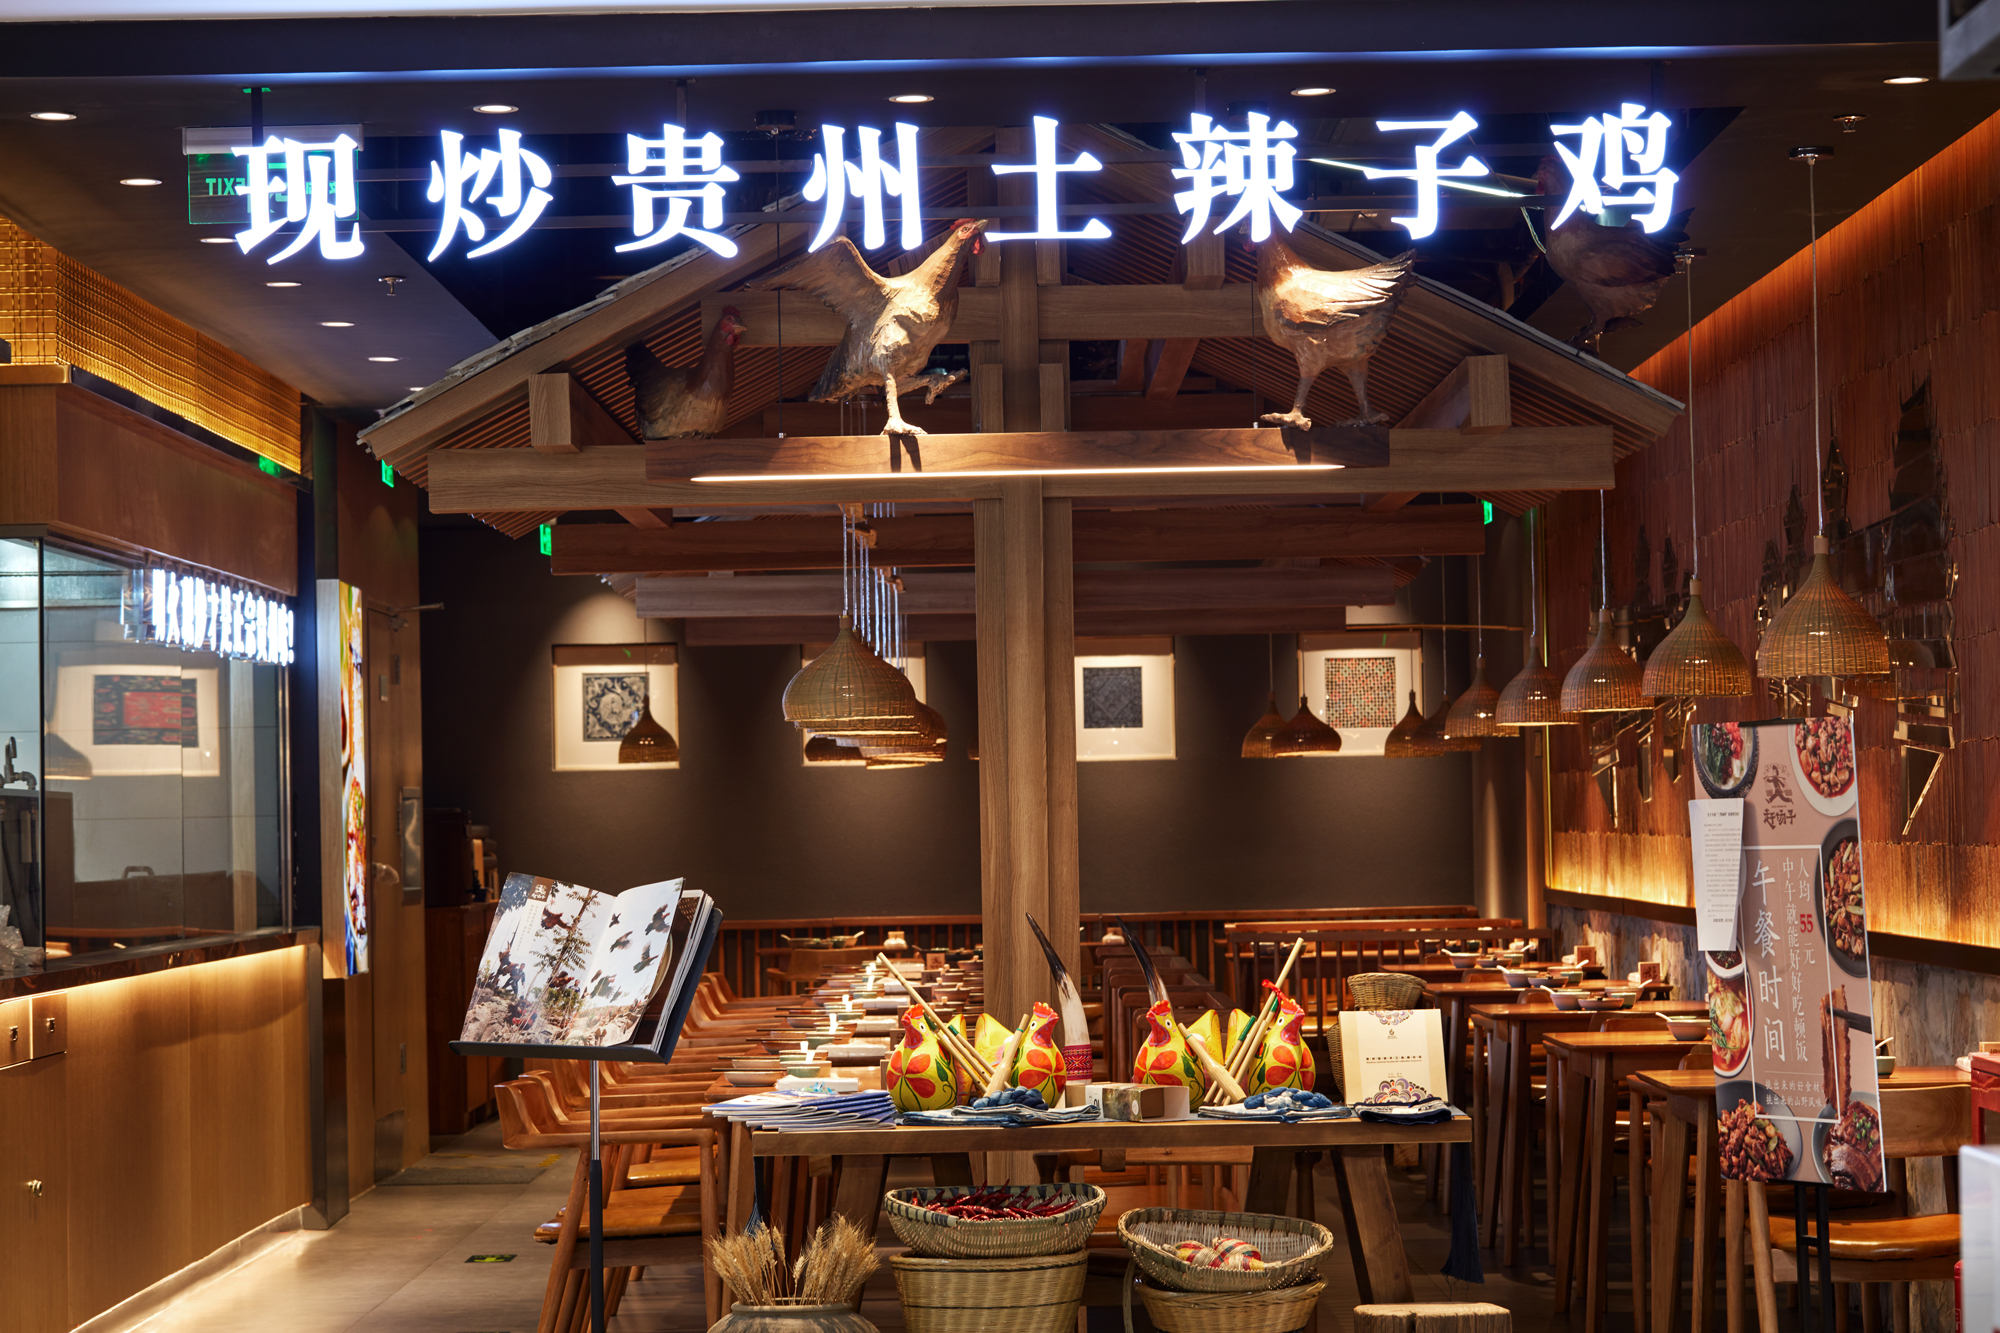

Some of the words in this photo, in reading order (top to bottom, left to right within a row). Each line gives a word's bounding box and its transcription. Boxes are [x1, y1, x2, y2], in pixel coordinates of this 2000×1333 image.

[231, 102, 1678, 264] 现炒贵州土辣子鸡
[1752, 860, 1786, 1063] 午餐时间
[1782, 857, 1808, 1062] 中午就能好好吃顿饭
